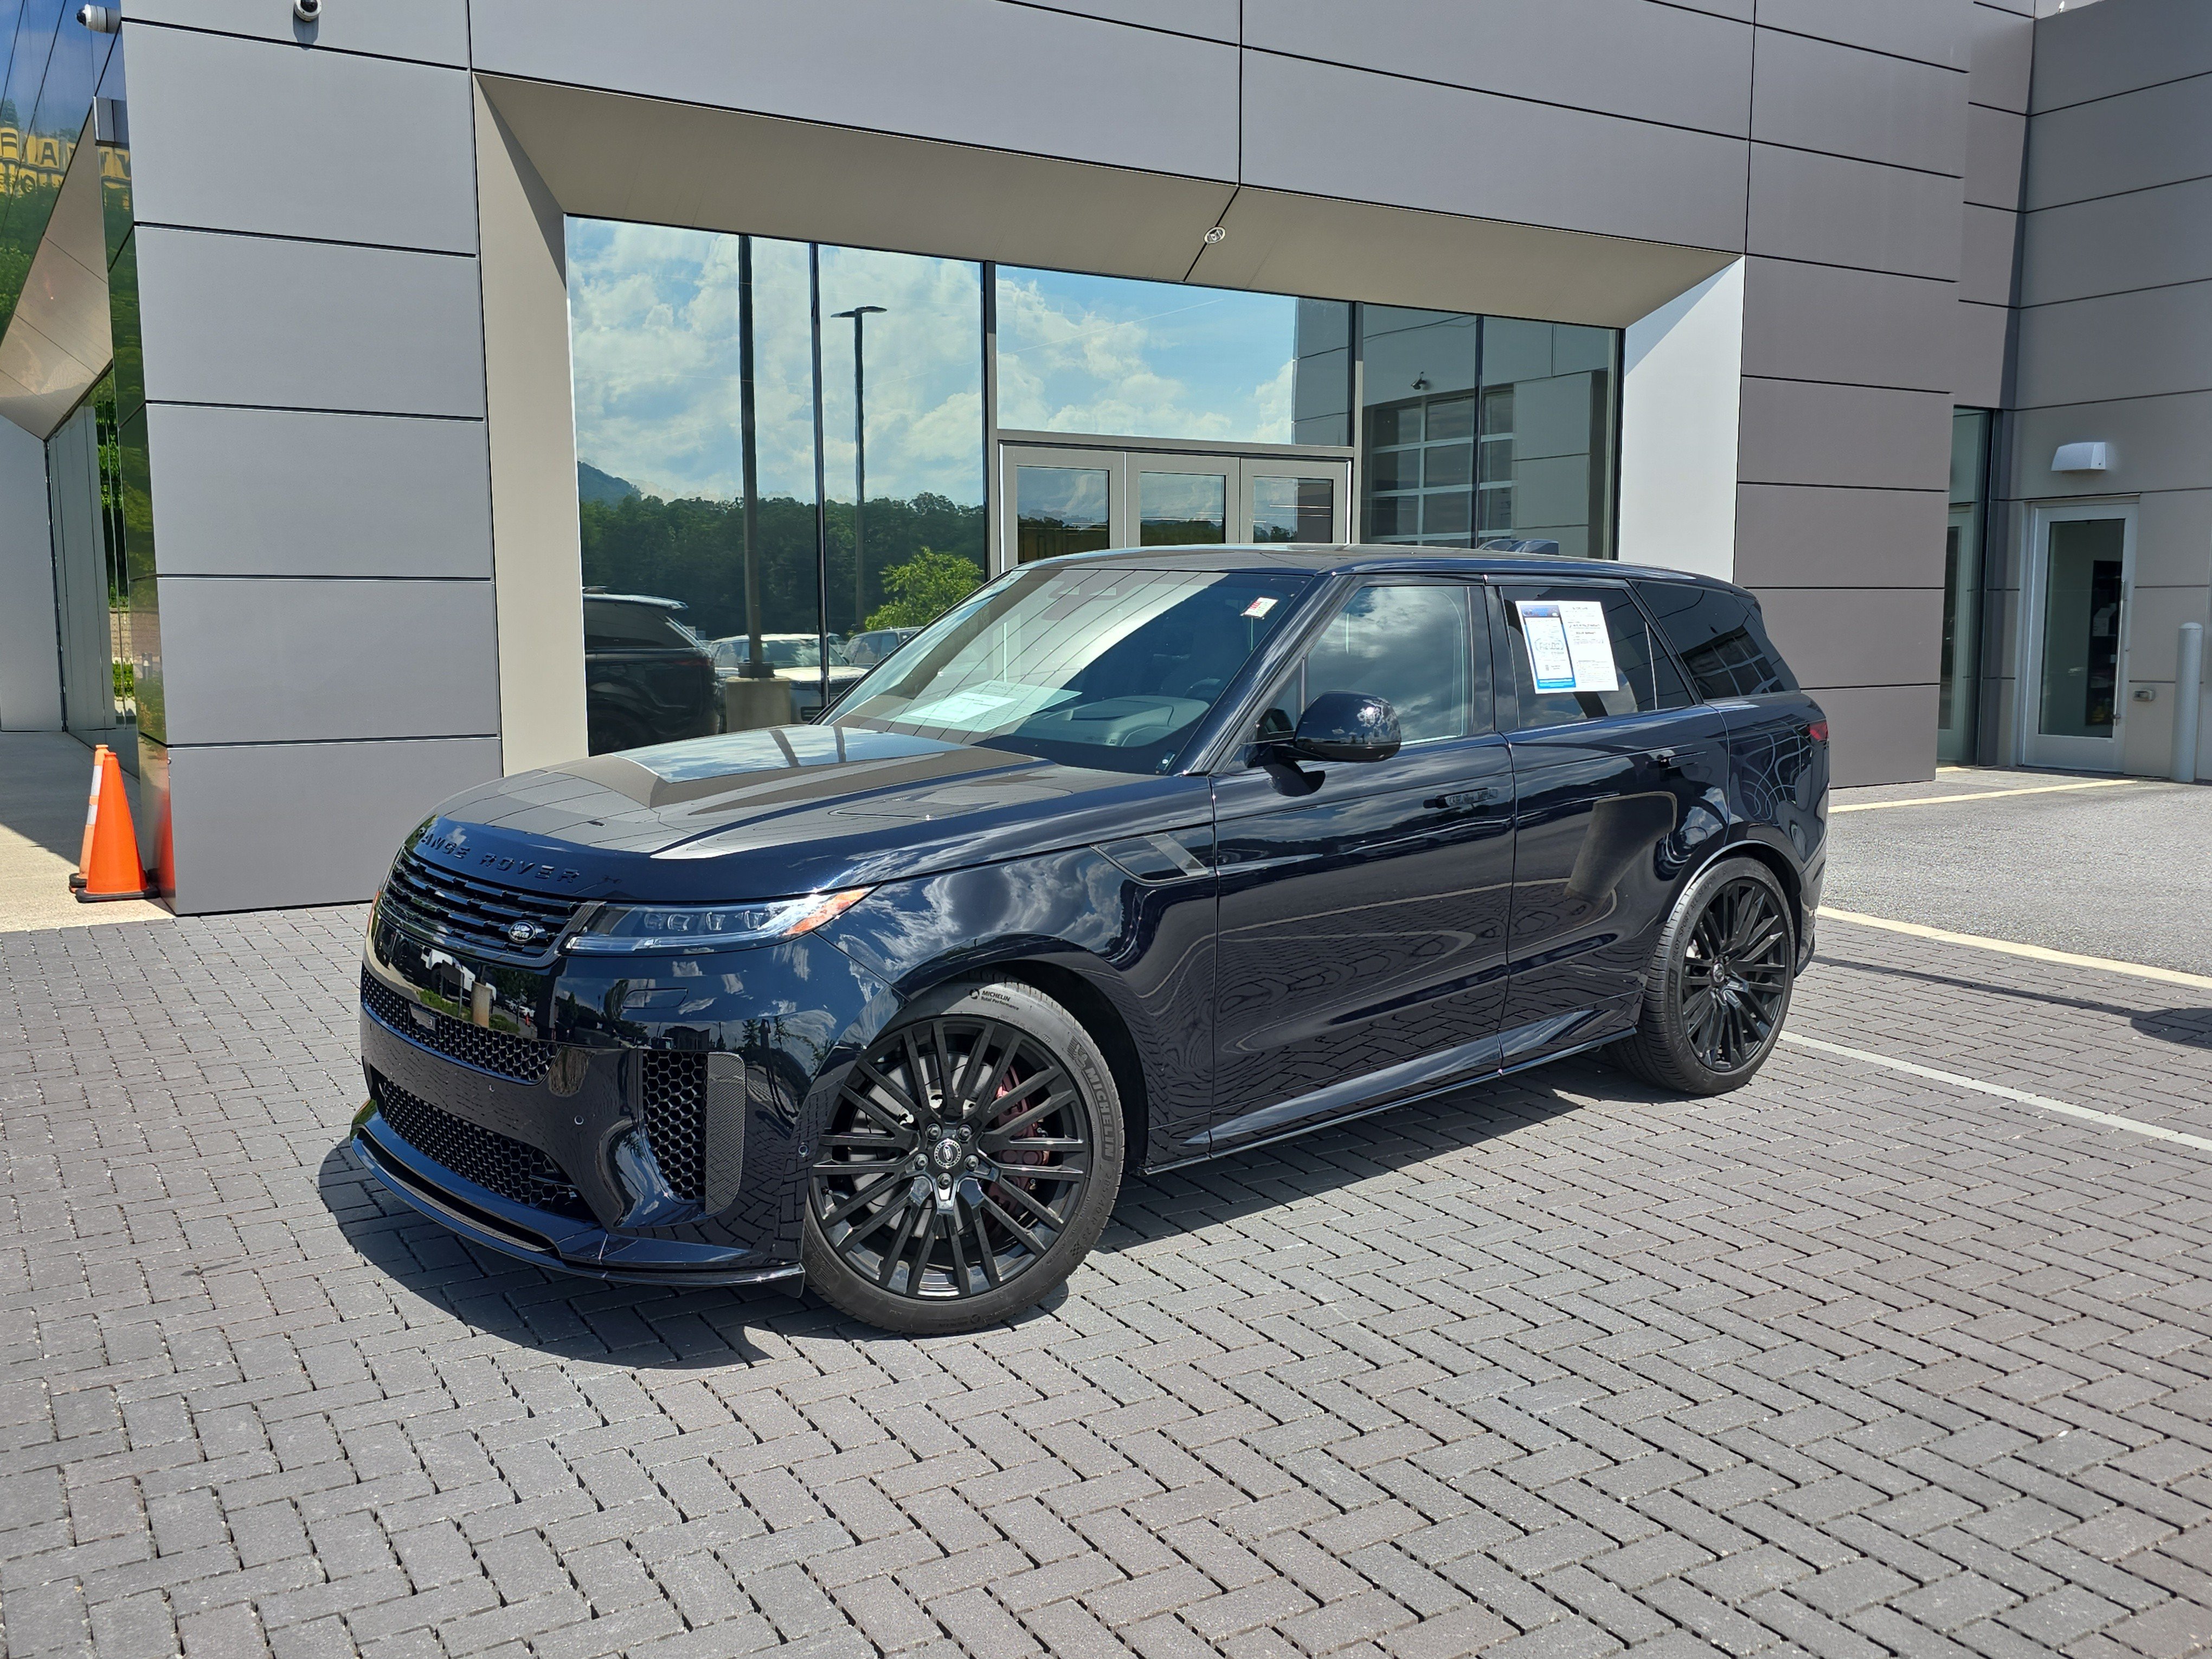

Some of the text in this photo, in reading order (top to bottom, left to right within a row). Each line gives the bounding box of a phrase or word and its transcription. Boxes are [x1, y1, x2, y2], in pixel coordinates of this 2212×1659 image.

[479, 853, 580, 883] ROVER
[1672, 940, 1681, 962] PILOT
[1680, 911, 1692, 937] SPORT
[982, 990, 1011, 1002] MICHELIN
[992, 999, 1020, 1011] Performance
[1085, 1068, 1115, 1158] MICHELIN
